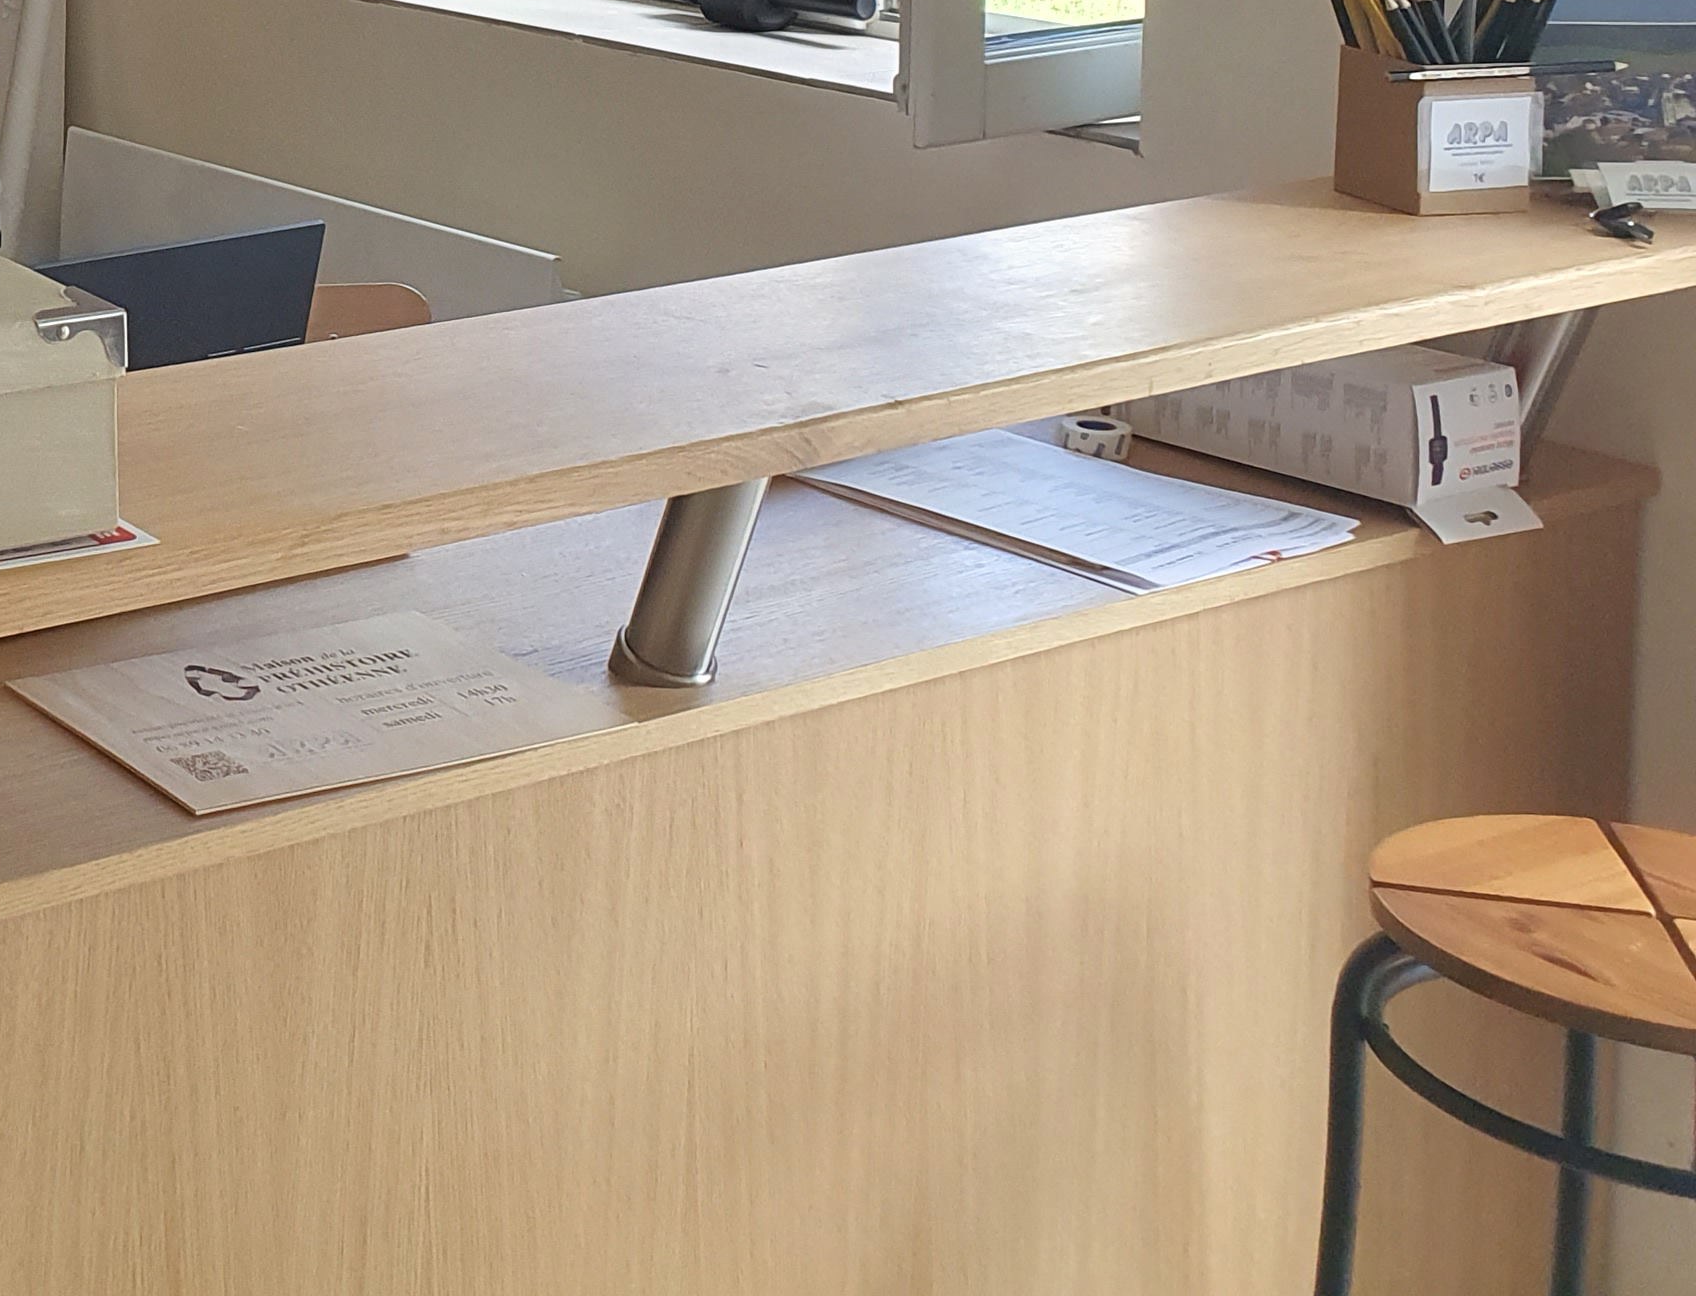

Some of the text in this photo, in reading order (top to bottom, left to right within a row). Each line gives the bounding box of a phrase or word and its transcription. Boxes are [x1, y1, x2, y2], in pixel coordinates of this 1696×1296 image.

[1447, 120, 1508, 145] ARPA
[1473, 173, 1485, 183] 1€
[1627, 174, 1692, 193] ARPA
[241, 648, 356, 673] Maison de la
[257, 648, 418, 684] PRÉHISTOIRE
[276, 665, 407, 694] OTHÉENNE
[336, 669, 494, 704] horaires d'ouverture
[361, 683, 510, 716] mercredi 14h30
[382, 694, 518, 729] samedi 17h
